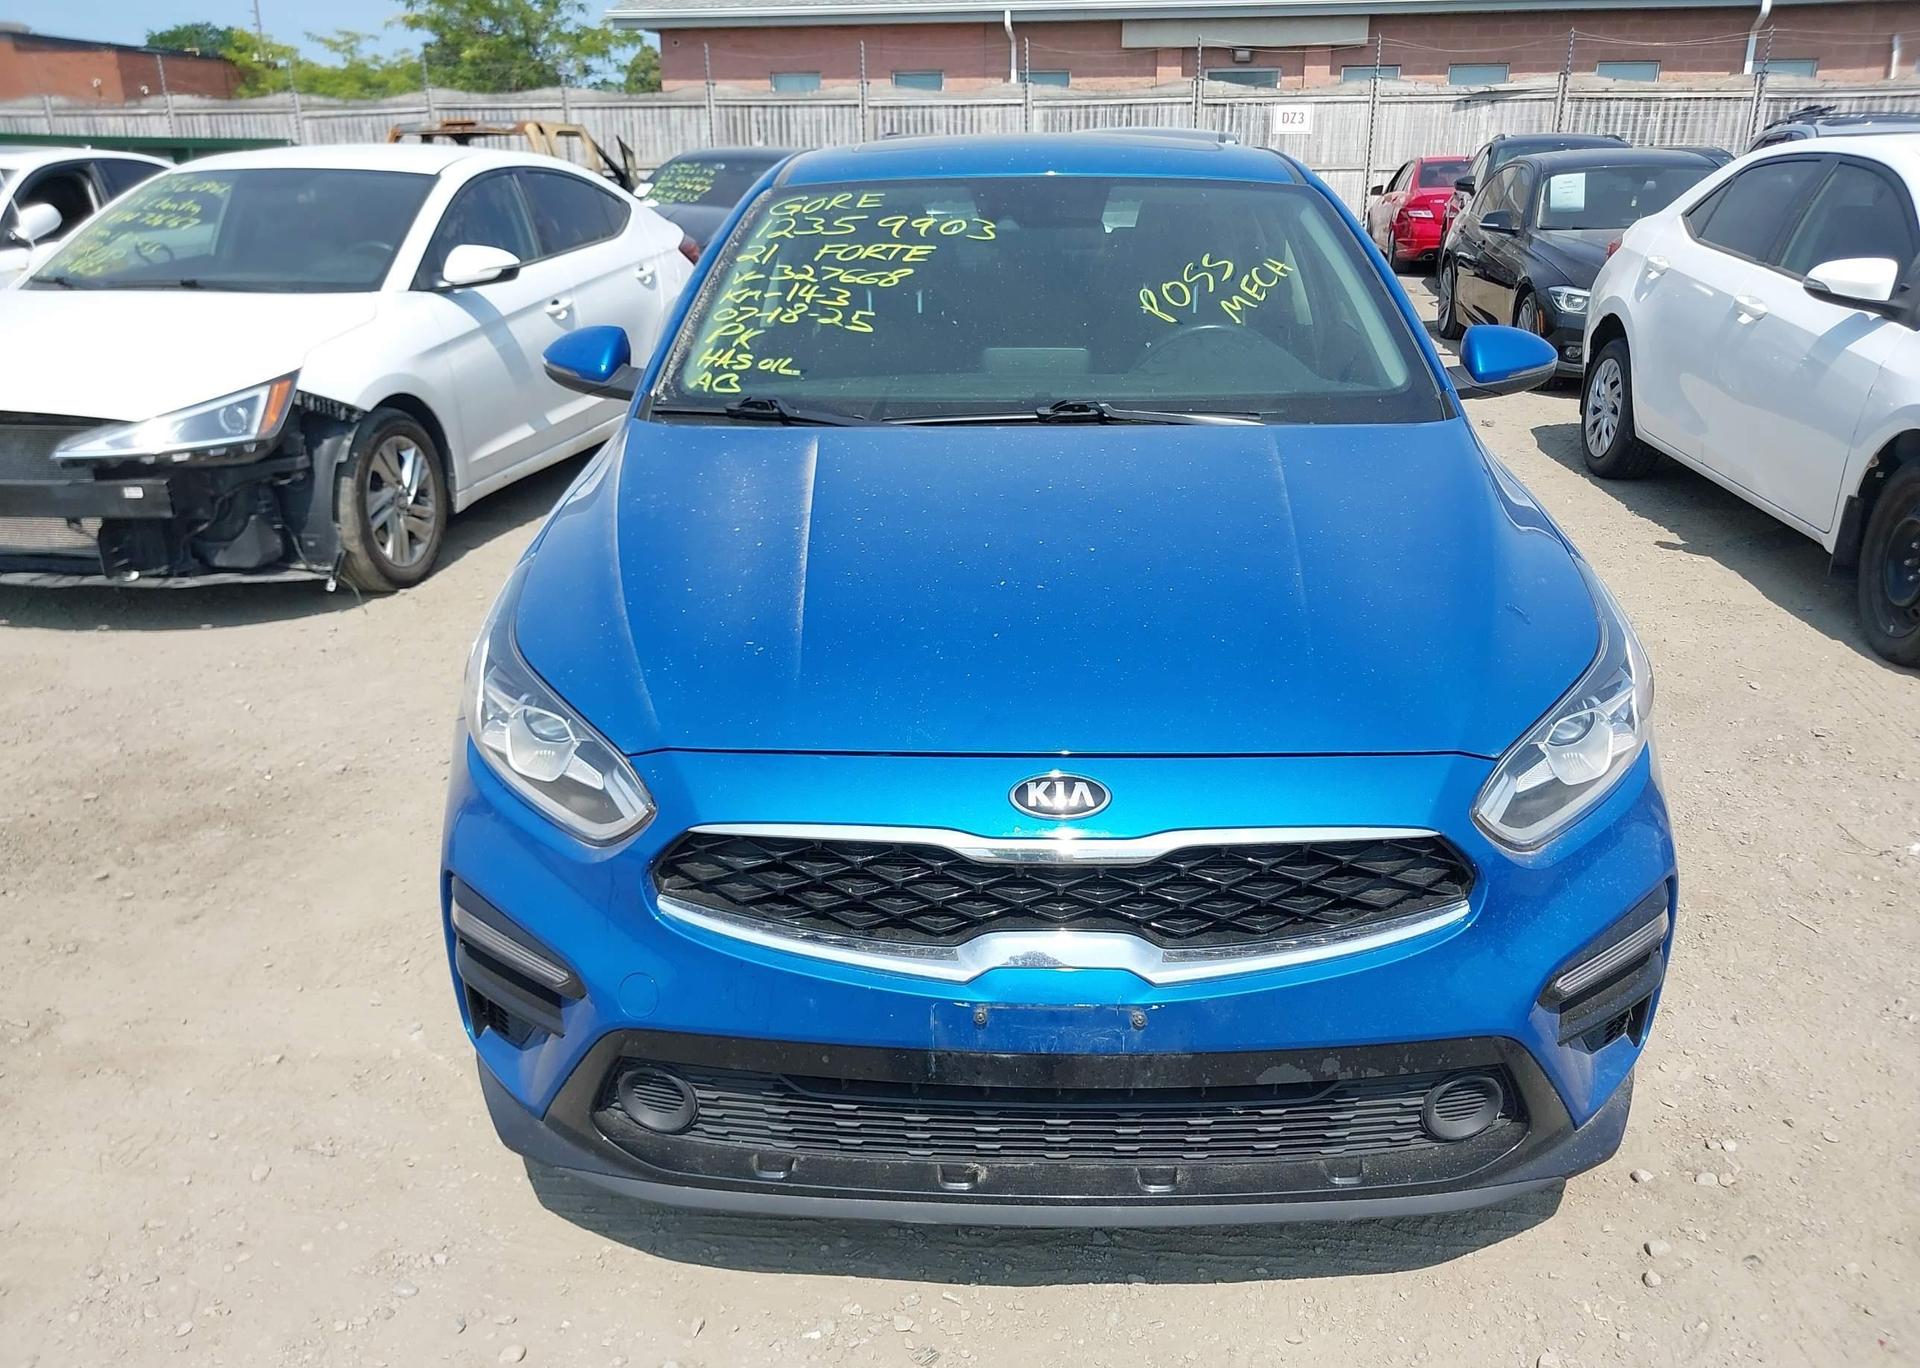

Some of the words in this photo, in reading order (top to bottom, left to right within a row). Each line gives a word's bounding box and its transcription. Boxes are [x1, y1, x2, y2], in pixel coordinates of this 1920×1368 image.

[1282, 111, 1304, 124] DZ3
[769, 193, 885, 216] GORE
[756, 215, 868, 239] 1235
[878, 215, 996, 240] 9903
[736, 244, 779, 265] 21
[814, 244, 937, 262] FORTE
[1139, 253, 1234, 323] POSS
[1220, 258, 1294, 324] MECH
[697, 348, 754, 370] HAS
[758, 357, 801, 376] OIL
[1026, 781, 1096, 808] KIA
